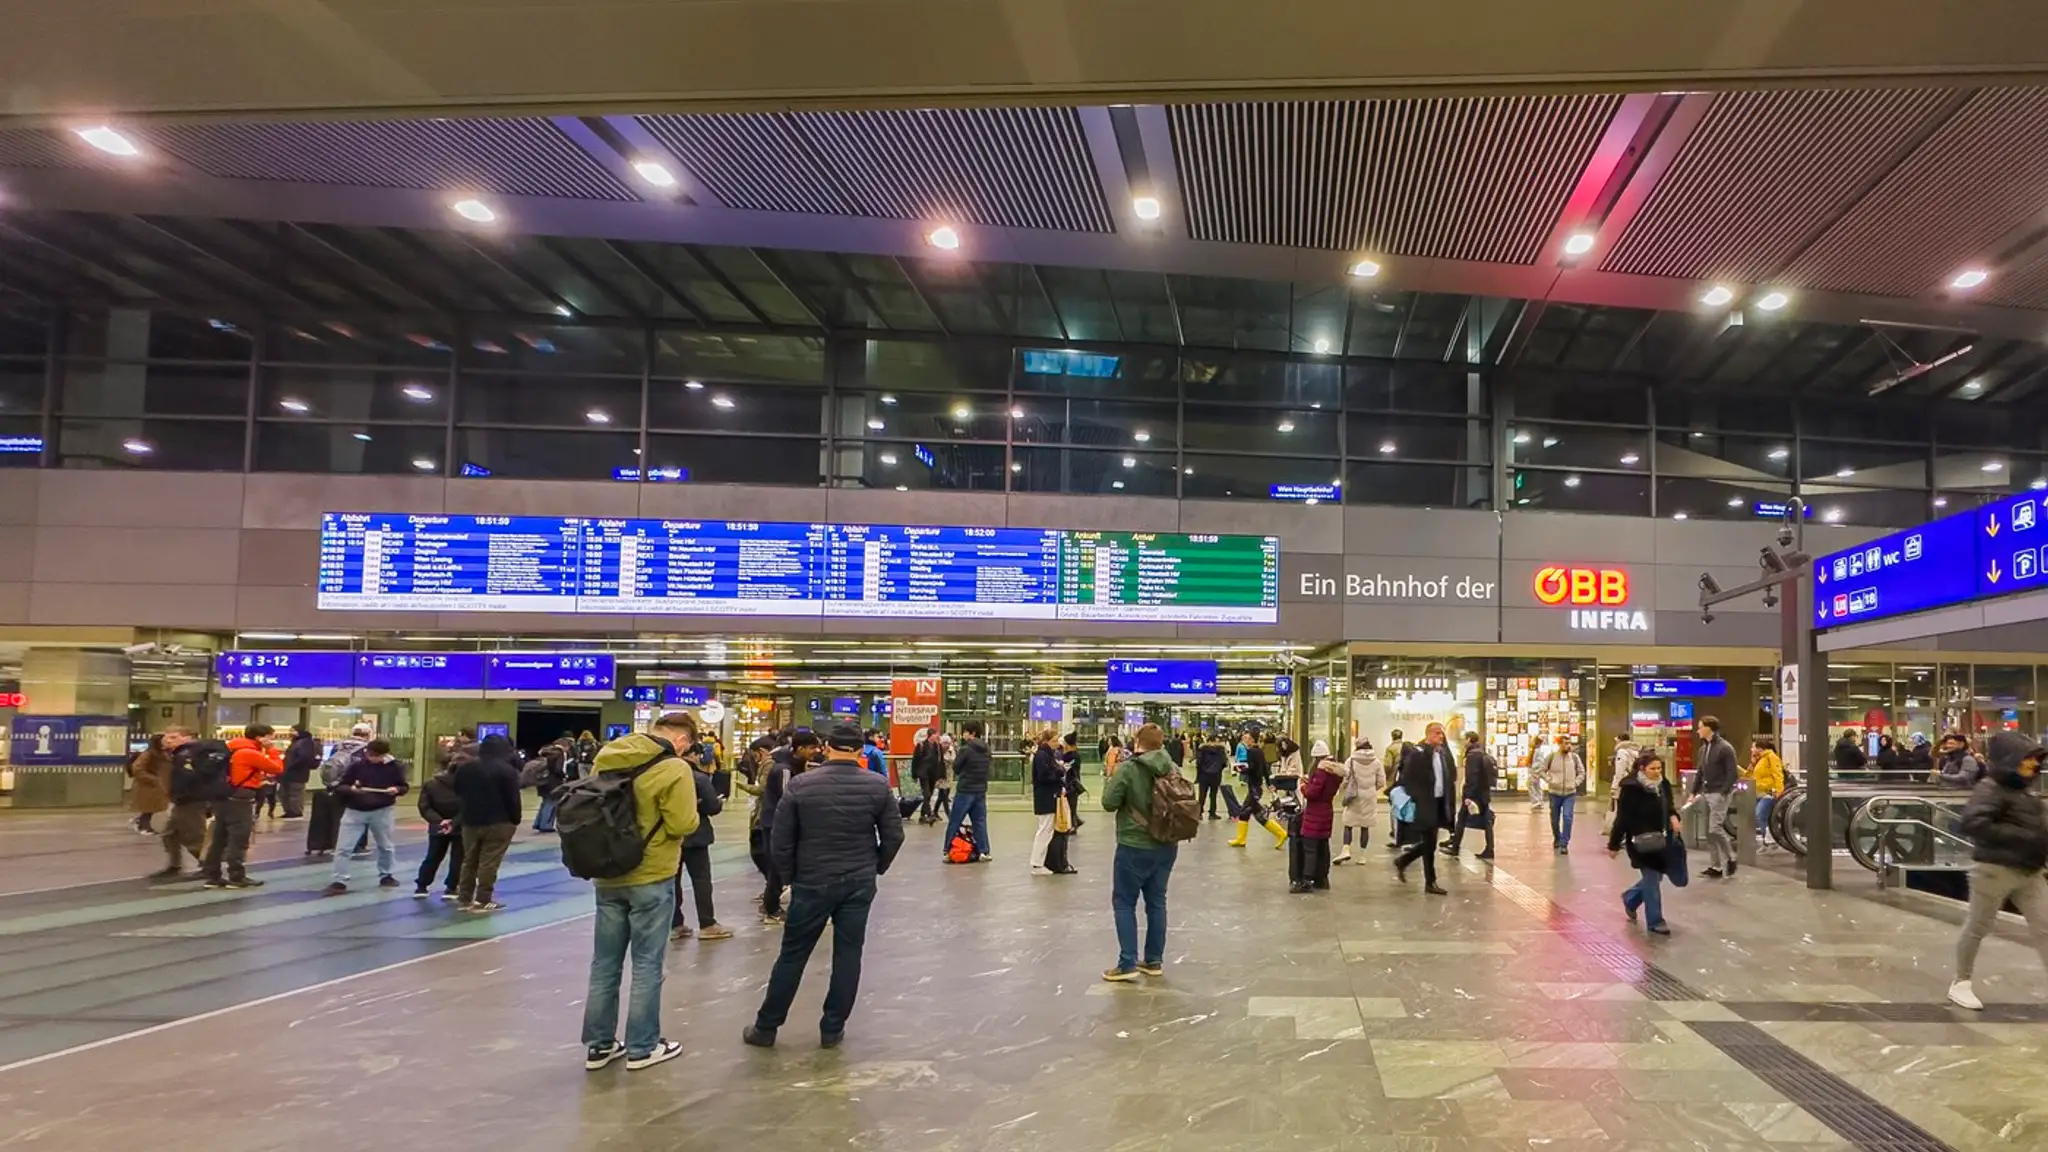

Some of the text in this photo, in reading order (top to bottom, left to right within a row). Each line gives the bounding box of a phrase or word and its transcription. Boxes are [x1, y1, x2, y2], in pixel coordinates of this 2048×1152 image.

[408, 516, 449, 524] Departure
[662, 521, 701, 529] Departure
[904, 528, 940, 536] Departure
[1883, 552, 1900, 566] WC
[1300, 573, 1336, 595] Ein
[1346, 574, 1449, 598] Bahnhof
[1455, 576, 1495, 599] der
[1534, 566, 1628, 605] ÖBB
[1571, 610, 1648, 630] INFRA
[916, 681, 936, 693] IN
[625, 689, 633, 698] 4
